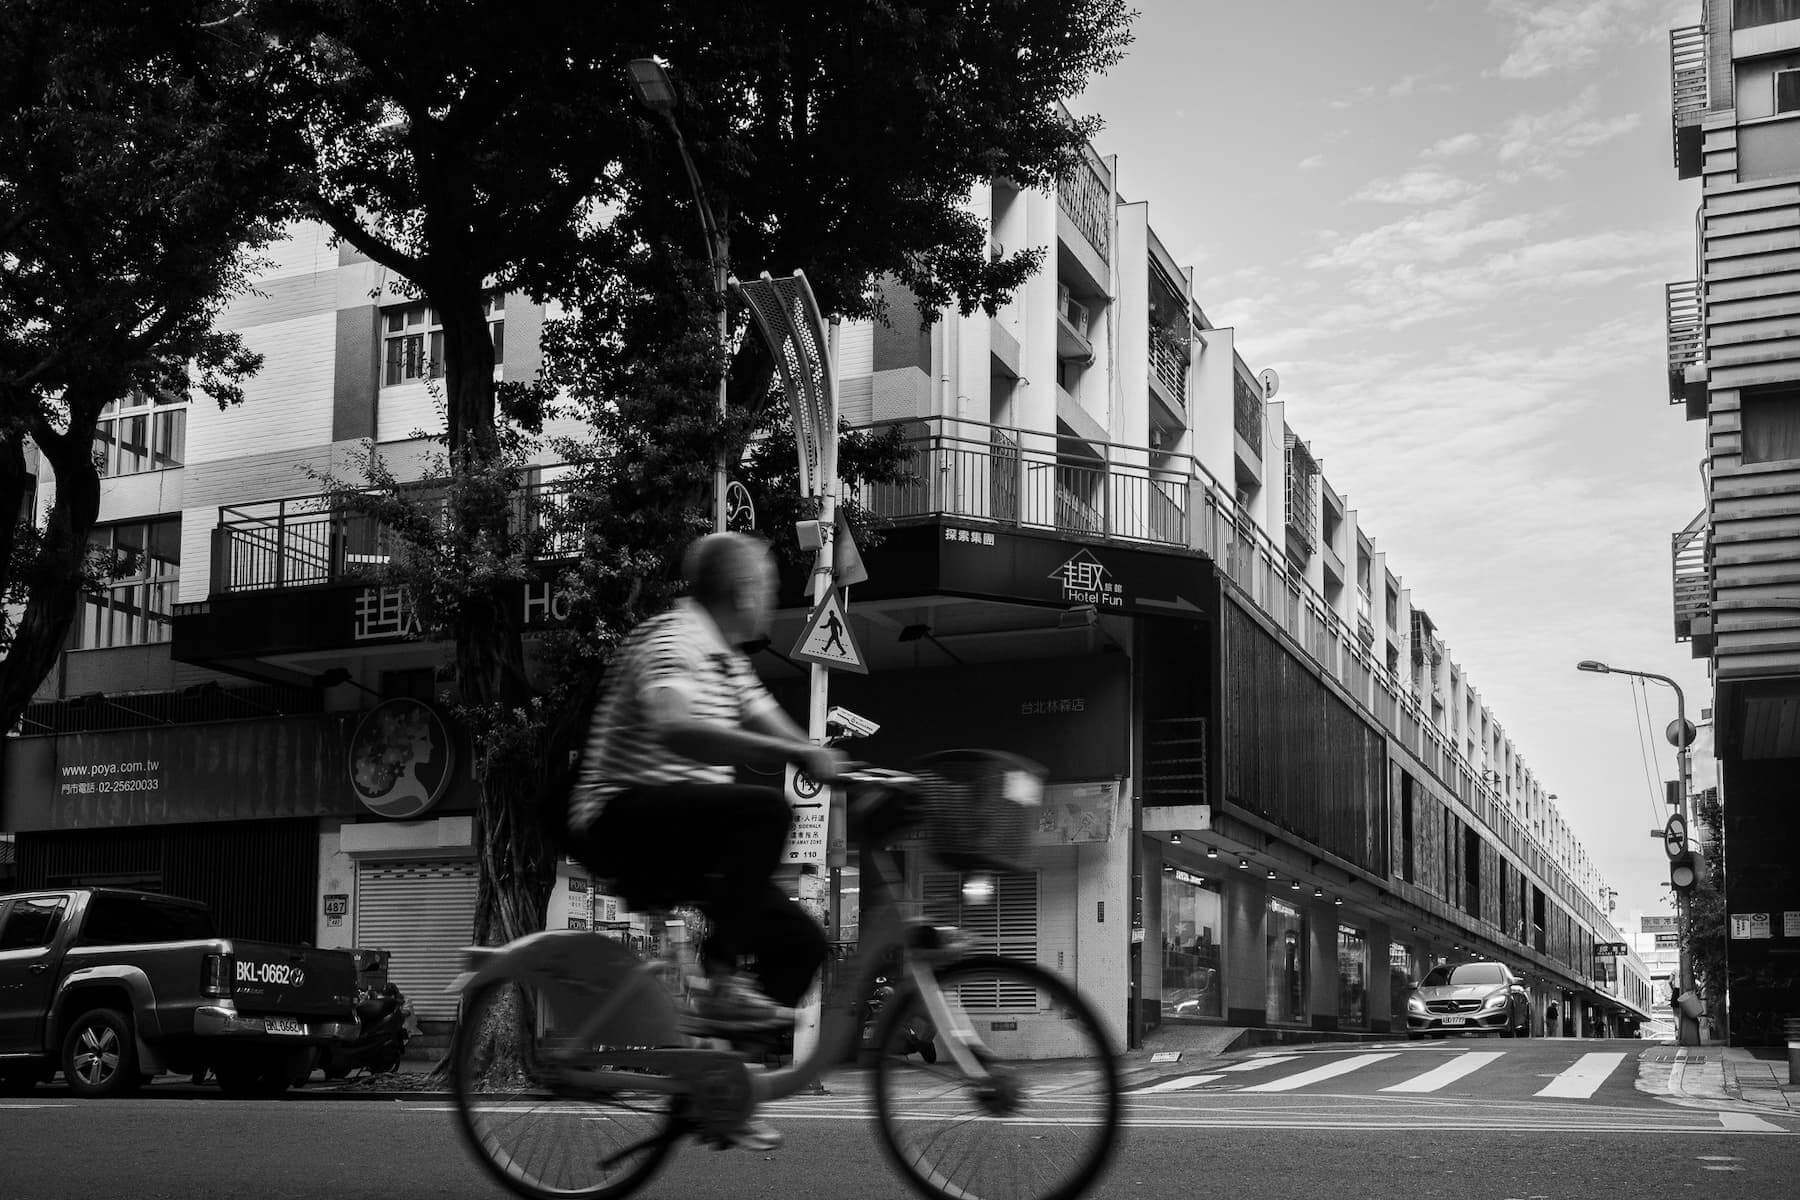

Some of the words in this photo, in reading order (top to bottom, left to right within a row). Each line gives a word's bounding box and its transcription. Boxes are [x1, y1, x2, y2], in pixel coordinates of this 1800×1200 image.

[945, 528, 995, 546] 探索集團
[1068, 590, 1099, 604] Hotel
[1102, 593, 1122, 606] Fun
[62, 760, 160, 777] www.poya.com.tw
[327, 902, 345, 912] 487
[236, 960, 290, 985] BKL-0662
